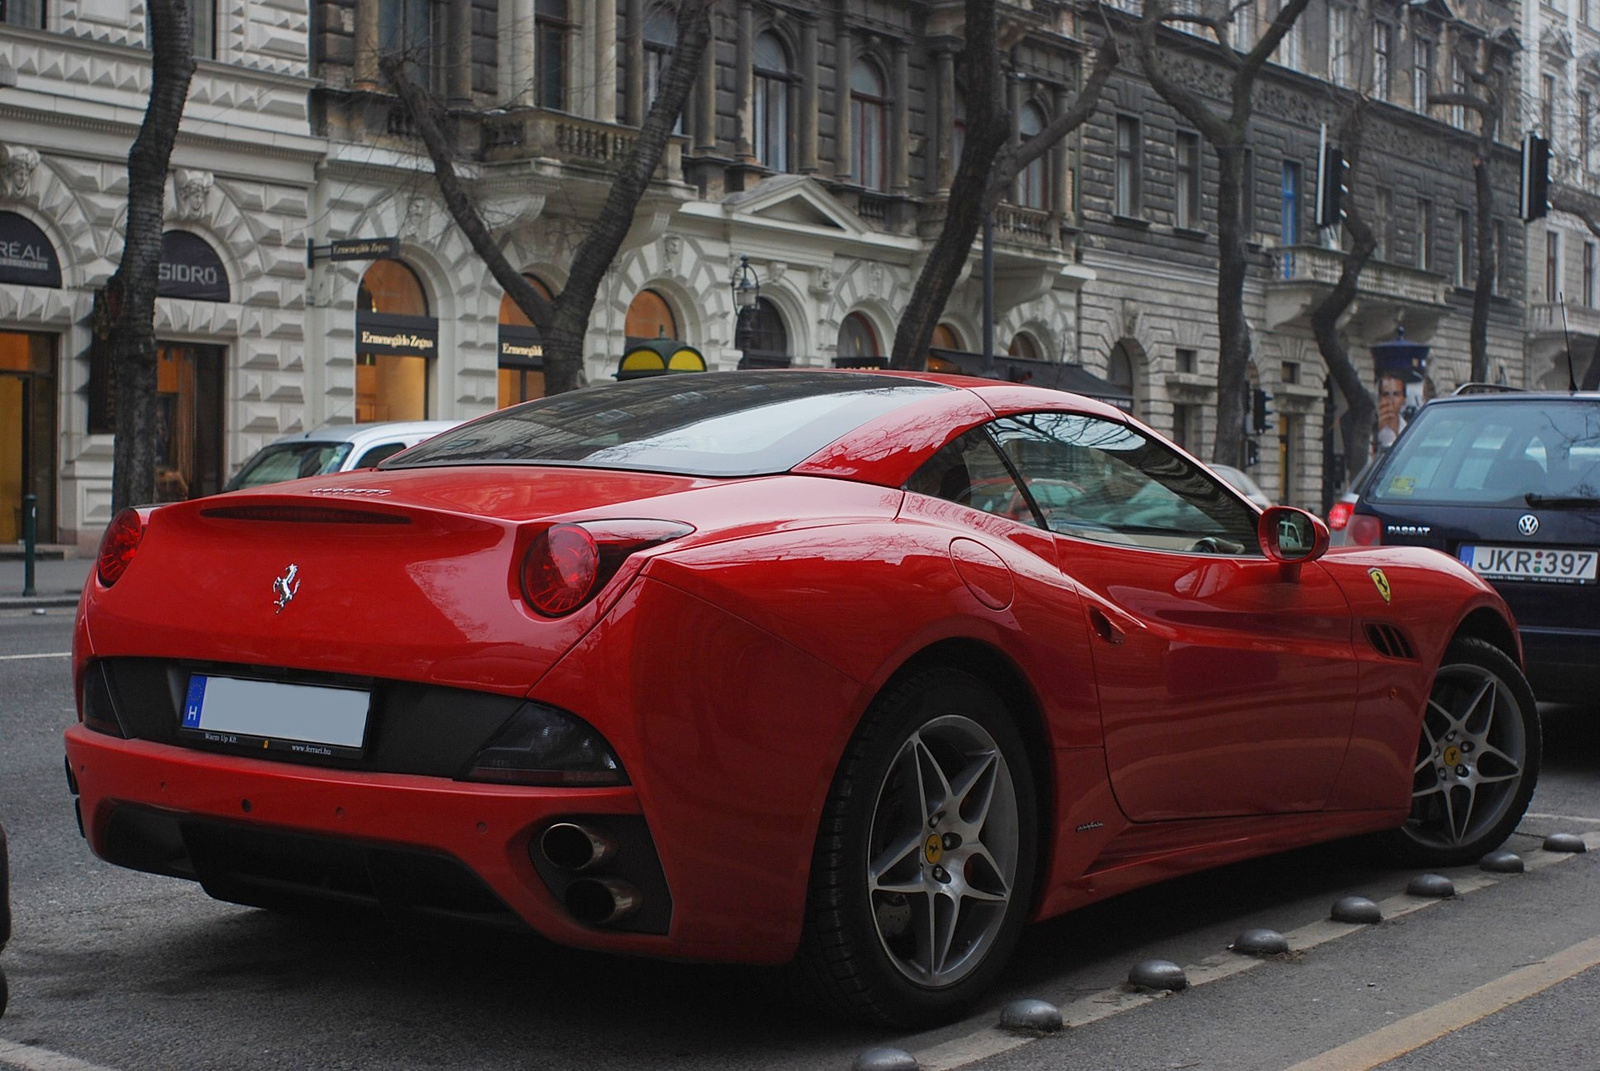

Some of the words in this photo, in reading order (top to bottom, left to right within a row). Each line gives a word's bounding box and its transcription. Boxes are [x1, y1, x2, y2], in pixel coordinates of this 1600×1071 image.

[362, 331, 410, 348] Ermenegildo
[410, 335, 433, 350] Zegna
[502, 342, 543, 358] Ermenegild
[1387, 525, 1431, 536] PASSAT
[187, 705, 198, 721] H
[205, 732, 220, 741] Warm
[220, 734, 228, 743] Up
[291, 744, 332, 756] www.ferrari.hu
